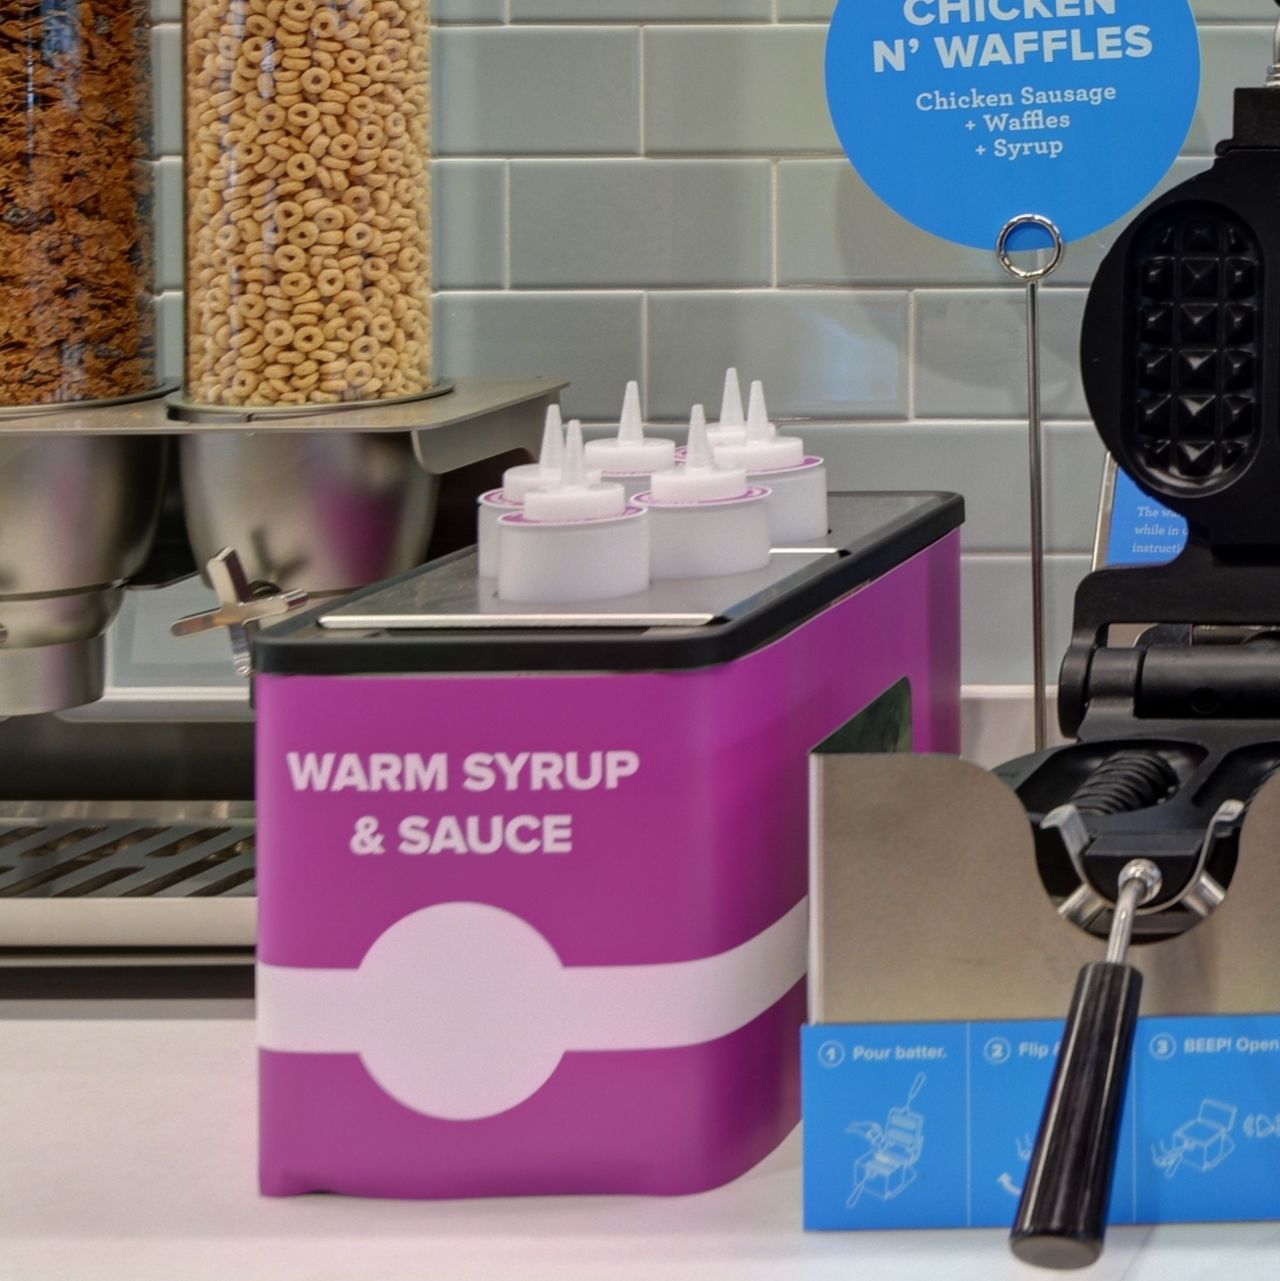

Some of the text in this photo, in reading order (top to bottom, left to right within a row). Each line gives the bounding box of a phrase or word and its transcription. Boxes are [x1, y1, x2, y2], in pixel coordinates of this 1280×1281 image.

[935, 25, 1153, 69] WAFFLES
[916, 85, 1116, 112] Chicken Sausage
[984, 111, 1071, 132] Waffles
[994, 138, 1064, 160] Syrup
[1137, 506, 1159, 517] The
[1135, 525, 1165, 535] while
[1168, 526, 1179, 535] in
[286, 751, 640, 792] WARM SYRUP
[349, 814, 573, 855] & SAUCE
[853, 1046, 892, 1061] Pour
[896, 1045, 946, 1060] batter.
[1019, 1042, 1049, 1059] Flip
